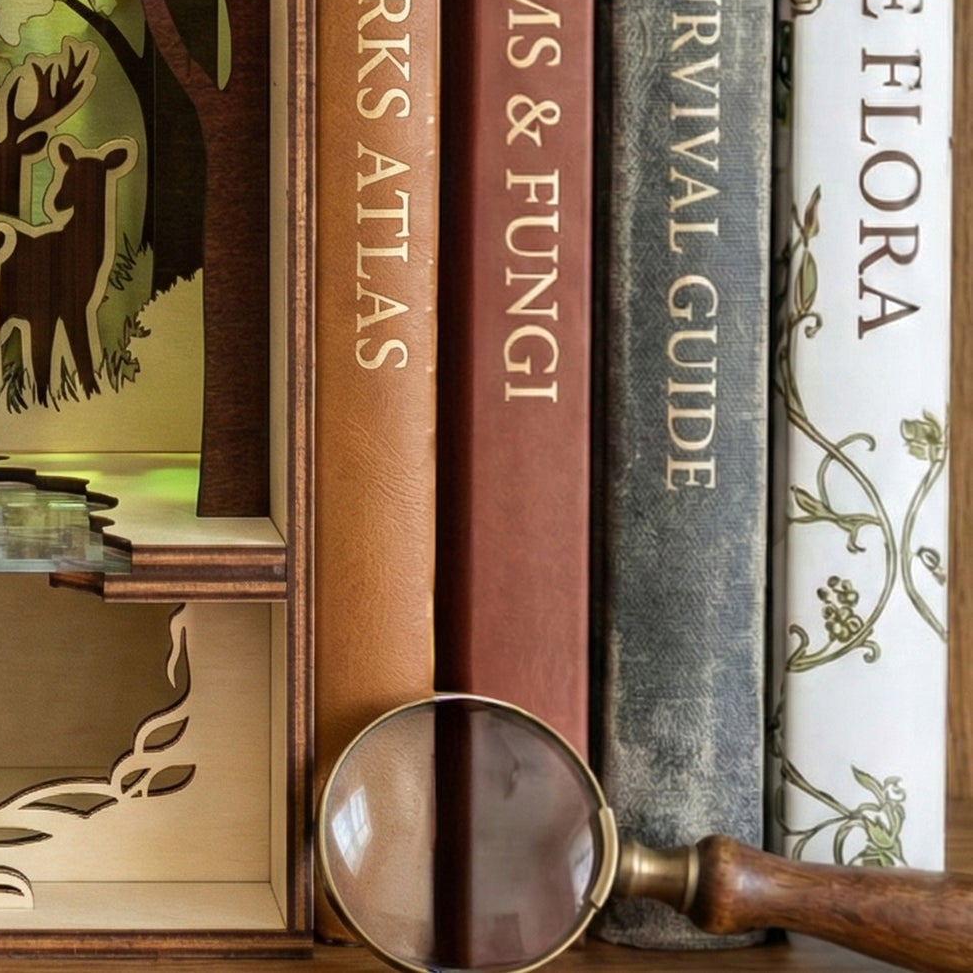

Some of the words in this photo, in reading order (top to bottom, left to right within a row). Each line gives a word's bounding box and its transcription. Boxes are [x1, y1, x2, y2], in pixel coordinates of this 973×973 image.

[506, 94, 561, 147] &
[857, 47, 922, 340] FLORA
[356, 141, 411, 369] ATLAS
[503, 169, 560, 403] FUNGI
[667, 274, 719, 490] GUIDE
